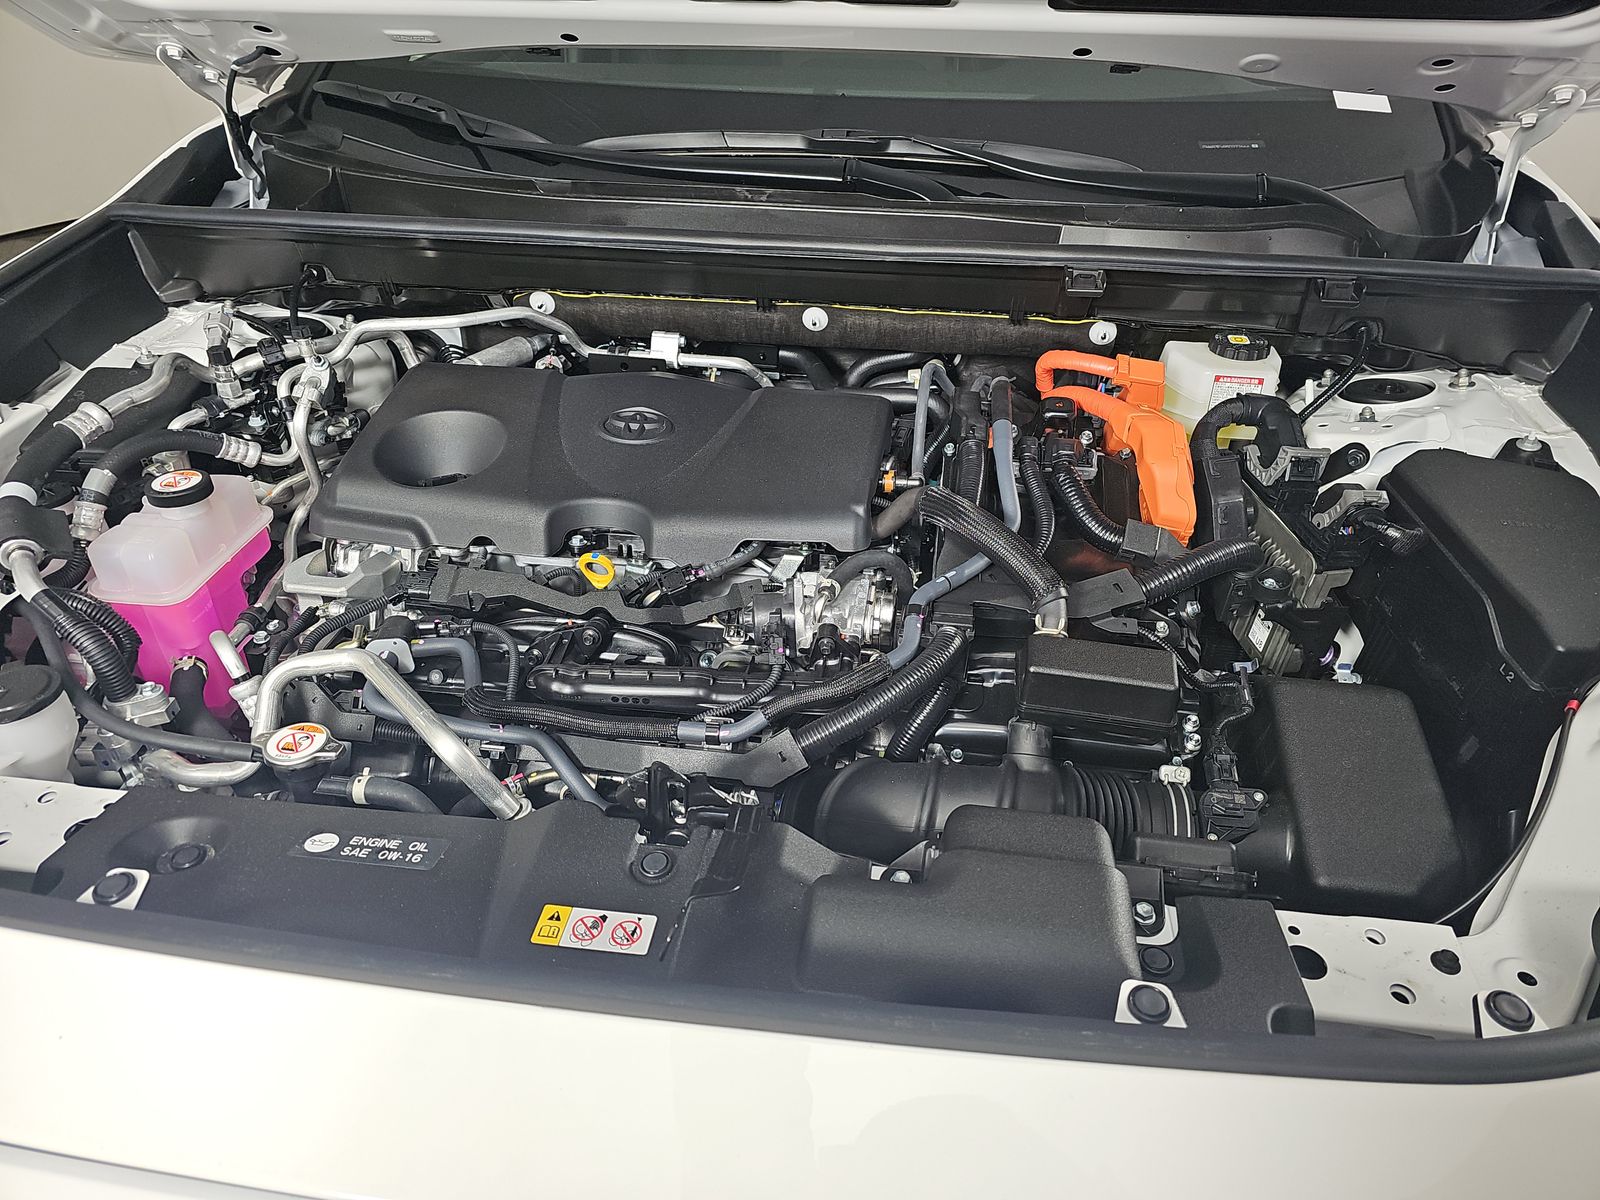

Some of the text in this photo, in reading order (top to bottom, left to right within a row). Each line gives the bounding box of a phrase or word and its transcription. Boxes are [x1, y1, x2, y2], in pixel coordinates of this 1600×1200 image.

[349, 836, 429, 852] ENGINE OIL
[340, 846, 423, 863] SAE 0W-16
